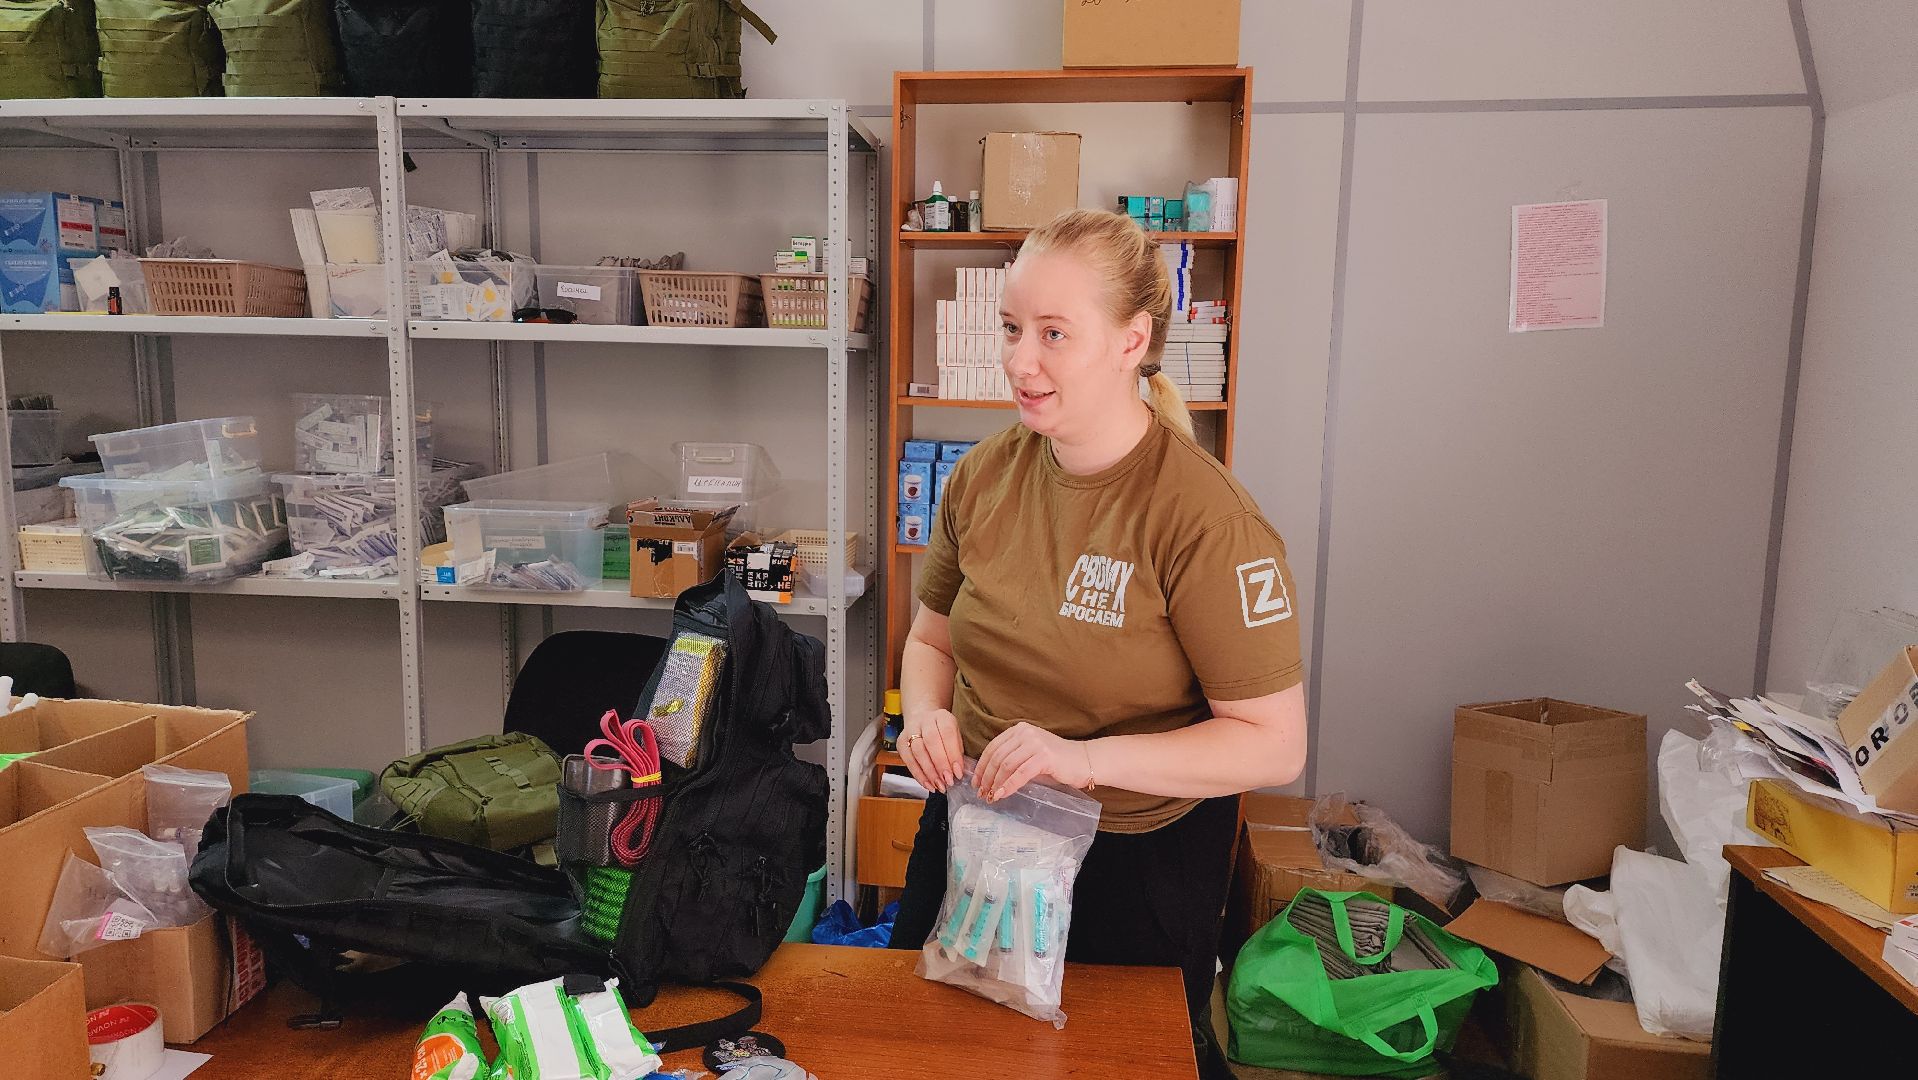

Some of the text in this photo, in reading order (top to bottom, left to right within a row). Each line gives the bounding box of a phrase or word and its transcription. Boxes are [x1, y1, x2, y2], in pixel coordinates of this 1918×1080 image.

[1081, 589, 1110, 610] НЕ
[1248, 568, 1285, 614] Z
[1059, 601, 1126, 628] БРОСАЕМ
